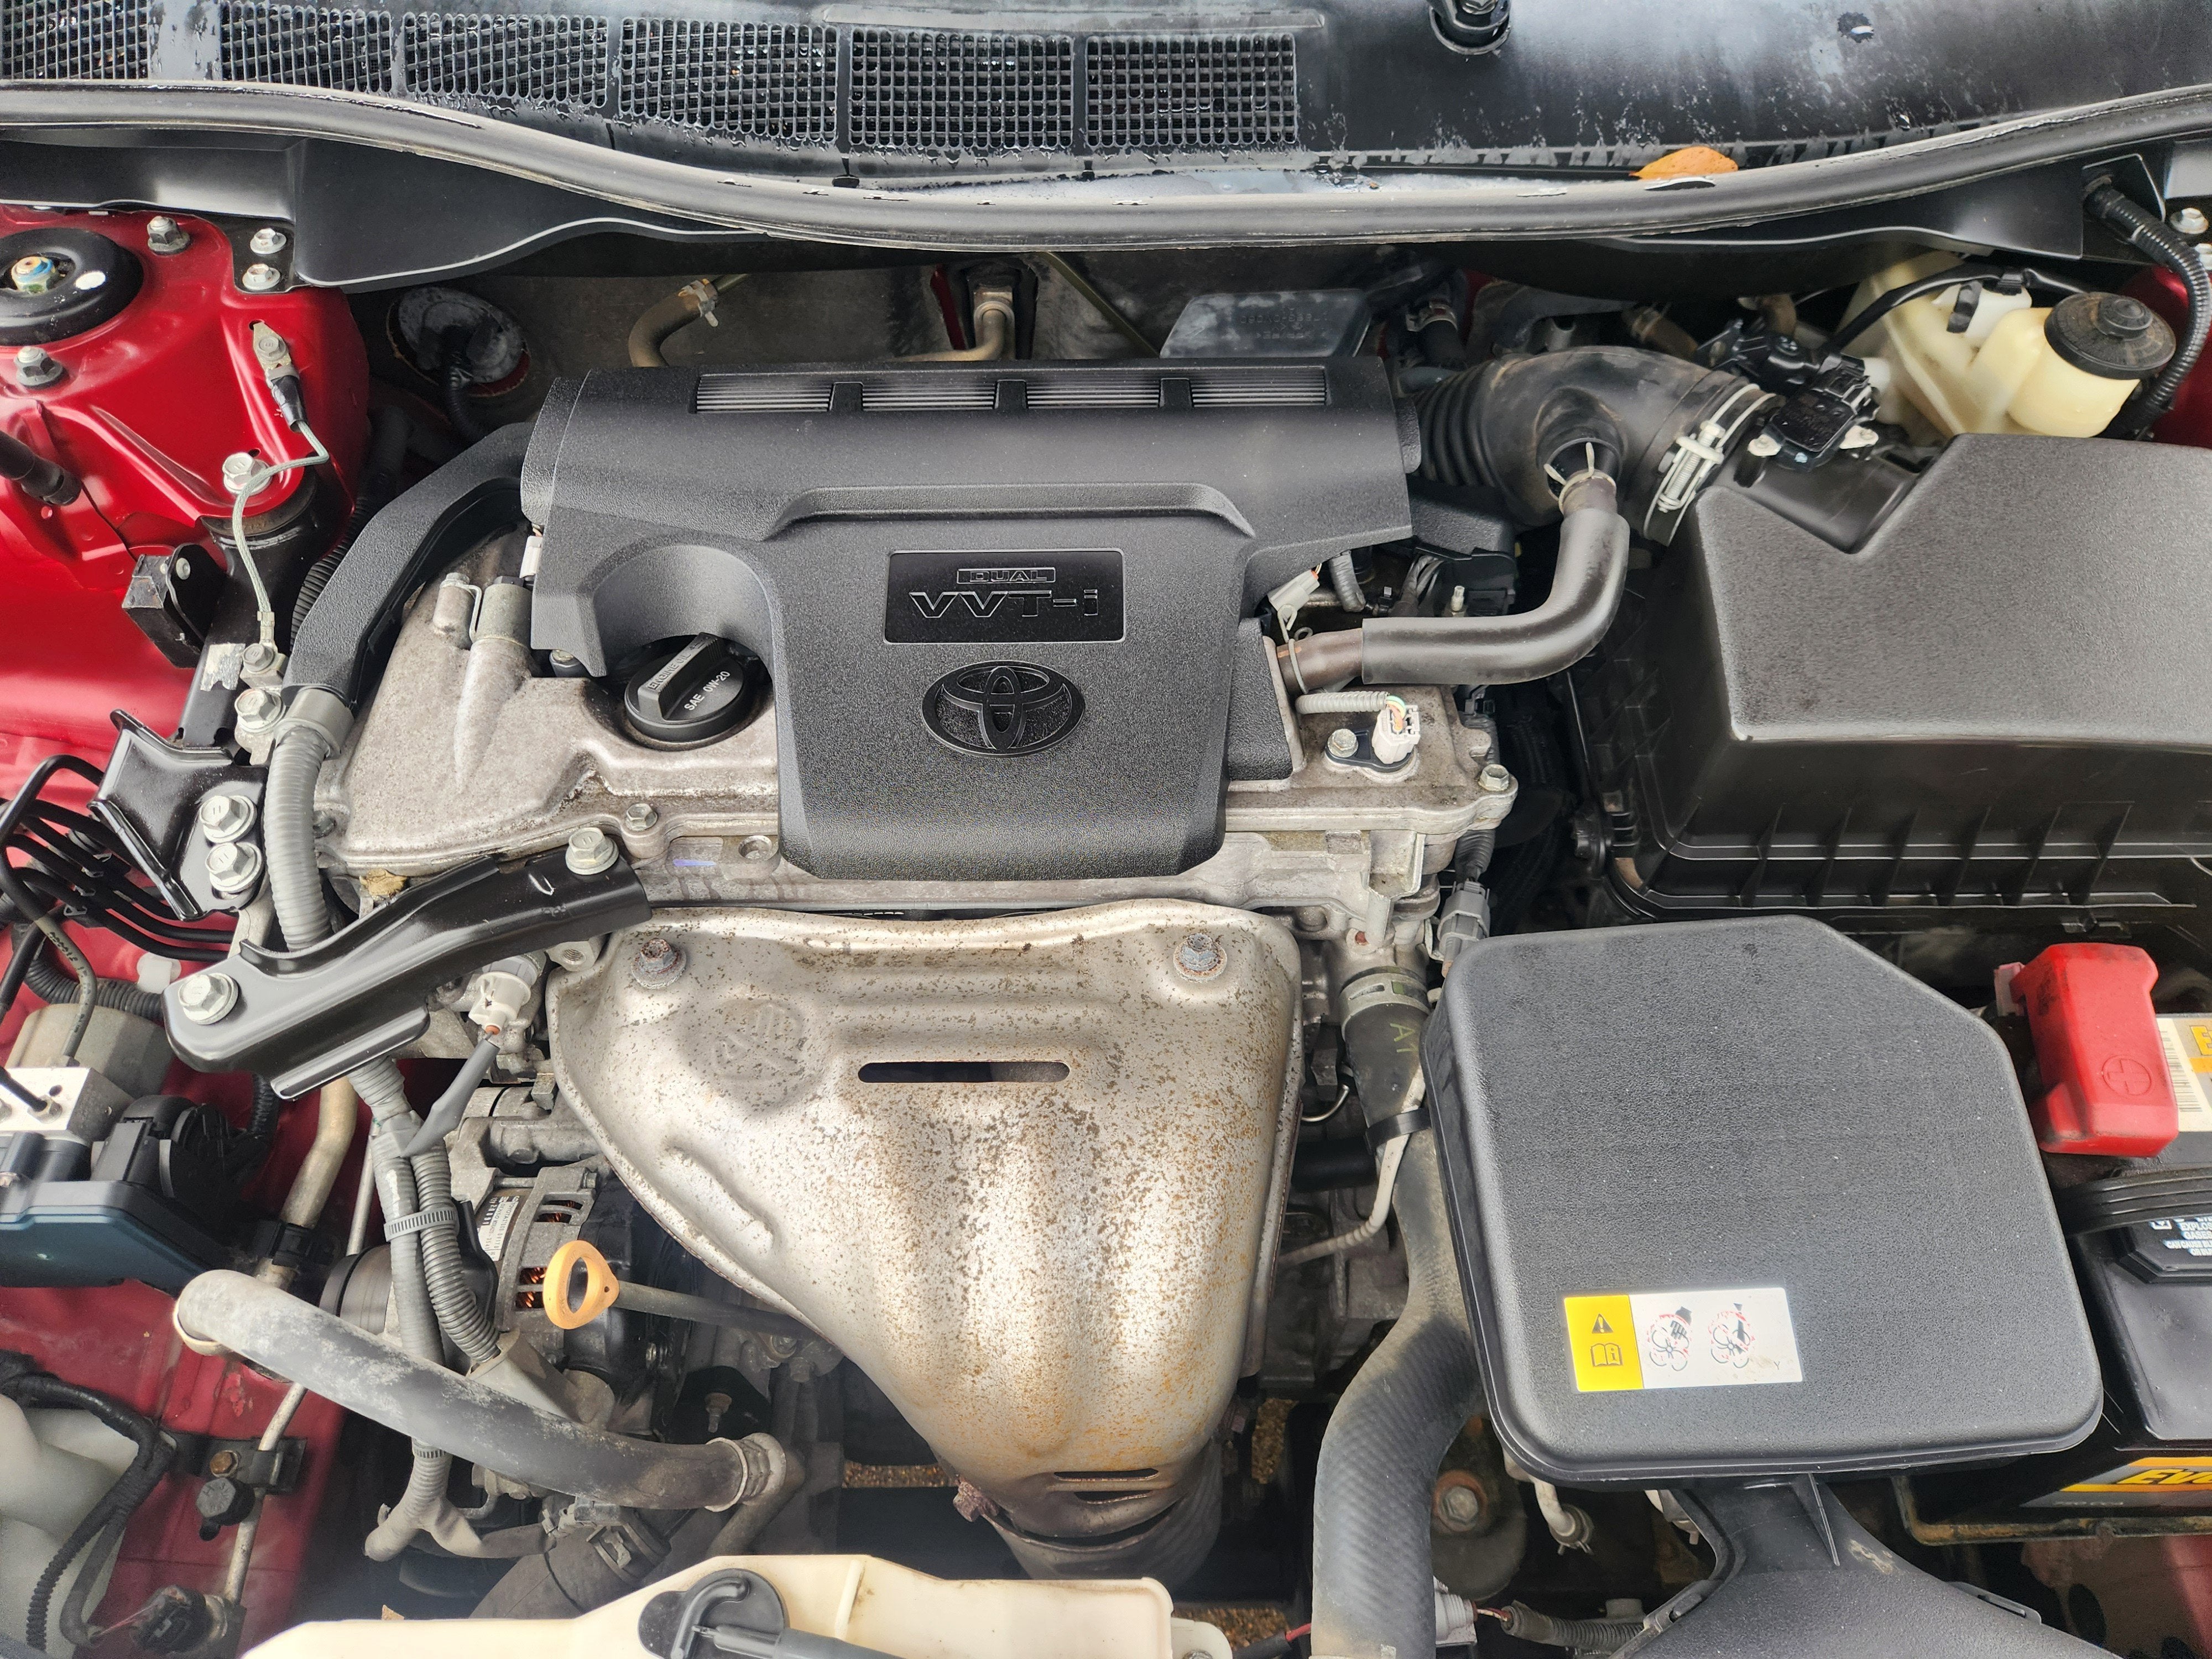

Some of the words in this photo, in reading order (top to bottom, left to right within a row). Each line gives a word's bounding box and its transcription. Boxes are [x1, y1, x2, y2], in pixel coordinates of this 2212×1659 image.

[969, 570, 1047, 583] DUAL
[909, 589, 1099, 619] VVT-i
[648, 662, 679, 690] ENGINE
[676, 653, 692, 665] OIL
[684, 693, 705, 711] SAE
[703, 671, 731, 692] 0W-20
[1390, 1023, 1419, 1053] A1
[2190, 1025, 2212, 1056] E
[494, 1203, 505, 1219] DENSO
[1773, 1361, 1781, 1370] Y
